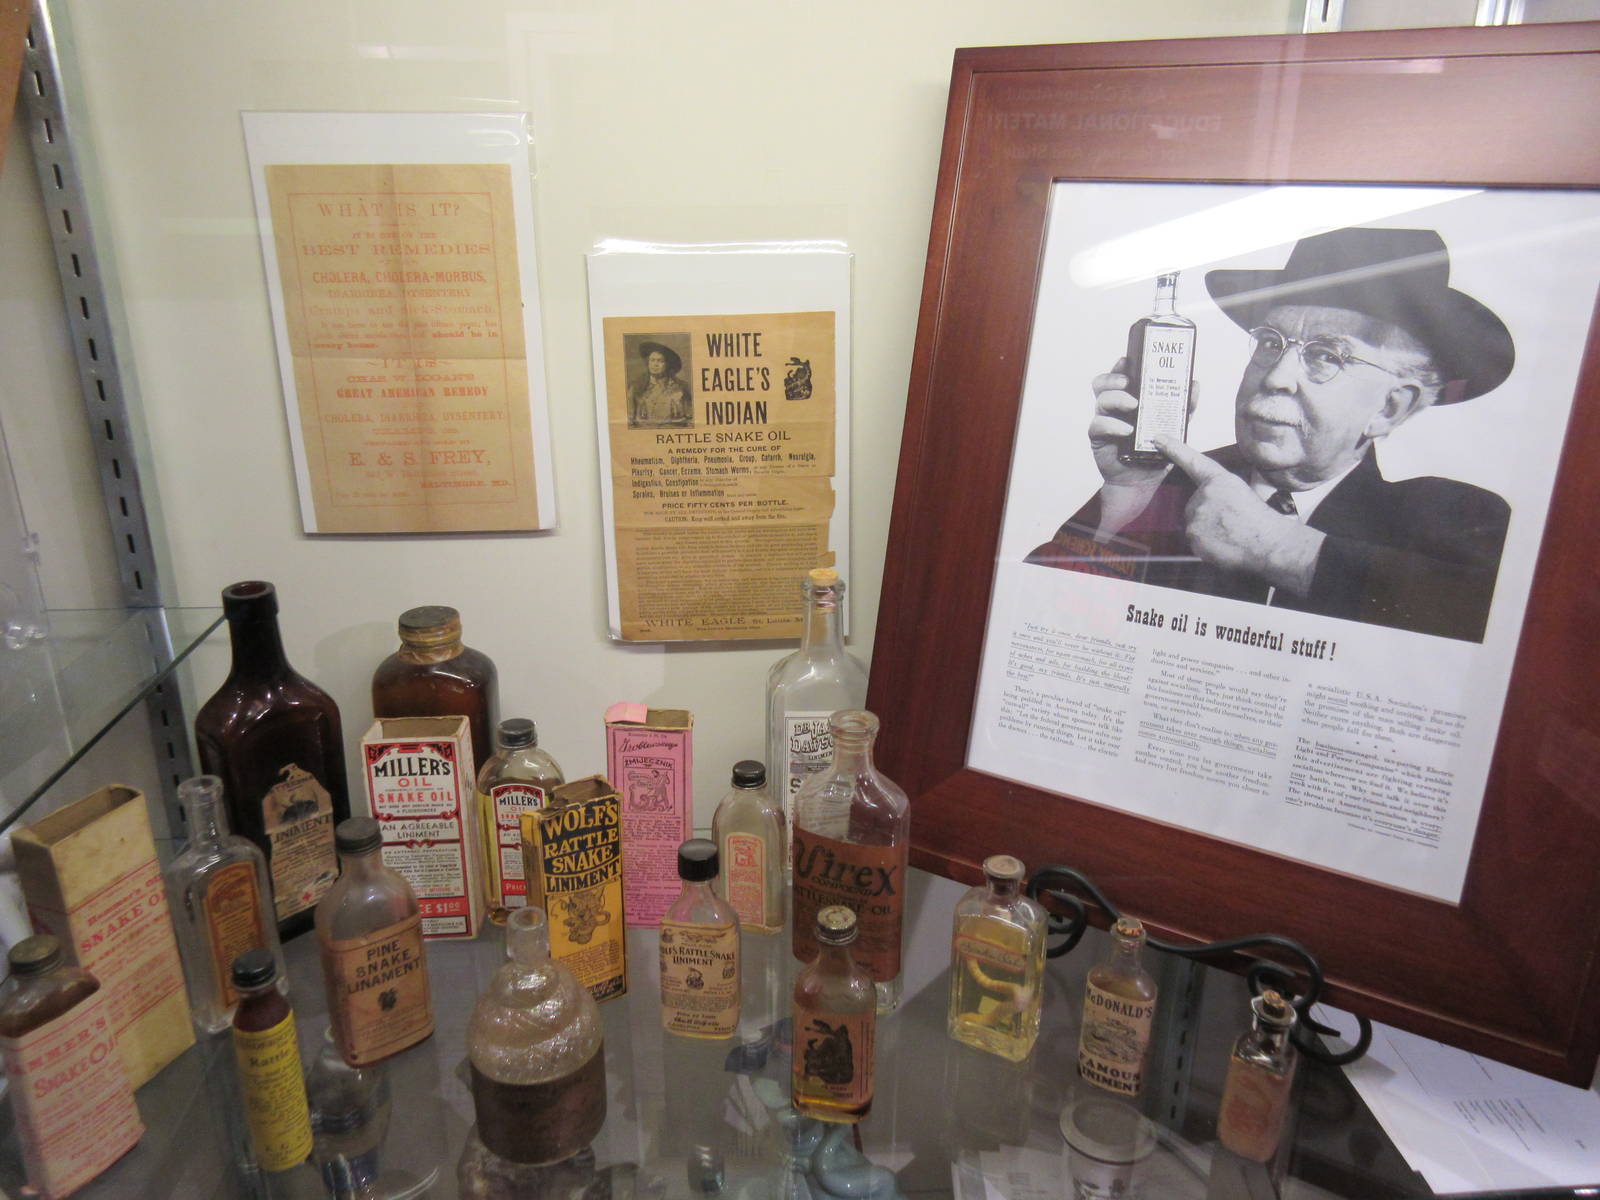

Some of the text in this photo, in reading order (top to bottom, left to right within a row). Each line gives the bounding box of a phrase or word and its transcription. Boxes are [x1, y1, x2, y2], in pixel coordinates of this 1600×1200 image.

[319, 203, 460, 217] WHAT IS IT?
[303, 243, 491, 256] BEST REMEDIES
[312, 271, 371, 284] CHOLERA,
[706, 332, 763, 358] WHITE
[1151, 341, 1185, 355] SNAKE
[1158, 356, 1176, 369] OIL
[701, 366, 771, 393] EAGLE'S
[336, 386, 489, 399] GREAT AMERICAN REMEDY
[705, 400, 768, 426] INDIAN
[656, 430, 791, 444] RATTLE SNAKE OIL
[676, 446, 707, 454] REMEDY
[710, 446, 726, 454] FOR
[728, 445, 744, 453] THE
[746, 445, 767, 453] CURE
[770, 444, 782, 452] OF
[377, 452, 394, 467] &
[430, 449, 492, 467] FREY,
[662, 502, 684, 510] PRICE
[645, 618, 694, 628] WHITE
[701, 617, 746, 627] EAGLE
[1126, 604, 1165, 629] Snake
[1170, 614, 1188, 633] oil
[1194, 616, 1208, 637] is
[1215, 622, 1284, 652] wonderful
[808, 751, 833, 761] LINIMEN
[398, 777, 432, 787] OIL
[378, 791, 454, 803] SNAKE OIL
[382, 821, 455, 832] AN AGREEABLE
[544, 801, 619, 841] WOLF'S
[397, 830, 440, 840] LINIMENT
[544, 828, 619, 859] RATTLE
[552, 845, 614, 874] SNAKE
[795, 837, 898, 897] Virex
[546, 859, 621, 893] LINIMENT
[80, 902, 145, 954] SNAKE
[367, 939, 401, 961] PINE
[356, 949, 412, 979] SNAKE
[347, 958, 421, 994] LINAMENT
[1085, 1058, 1141, 1082] AMOUS
